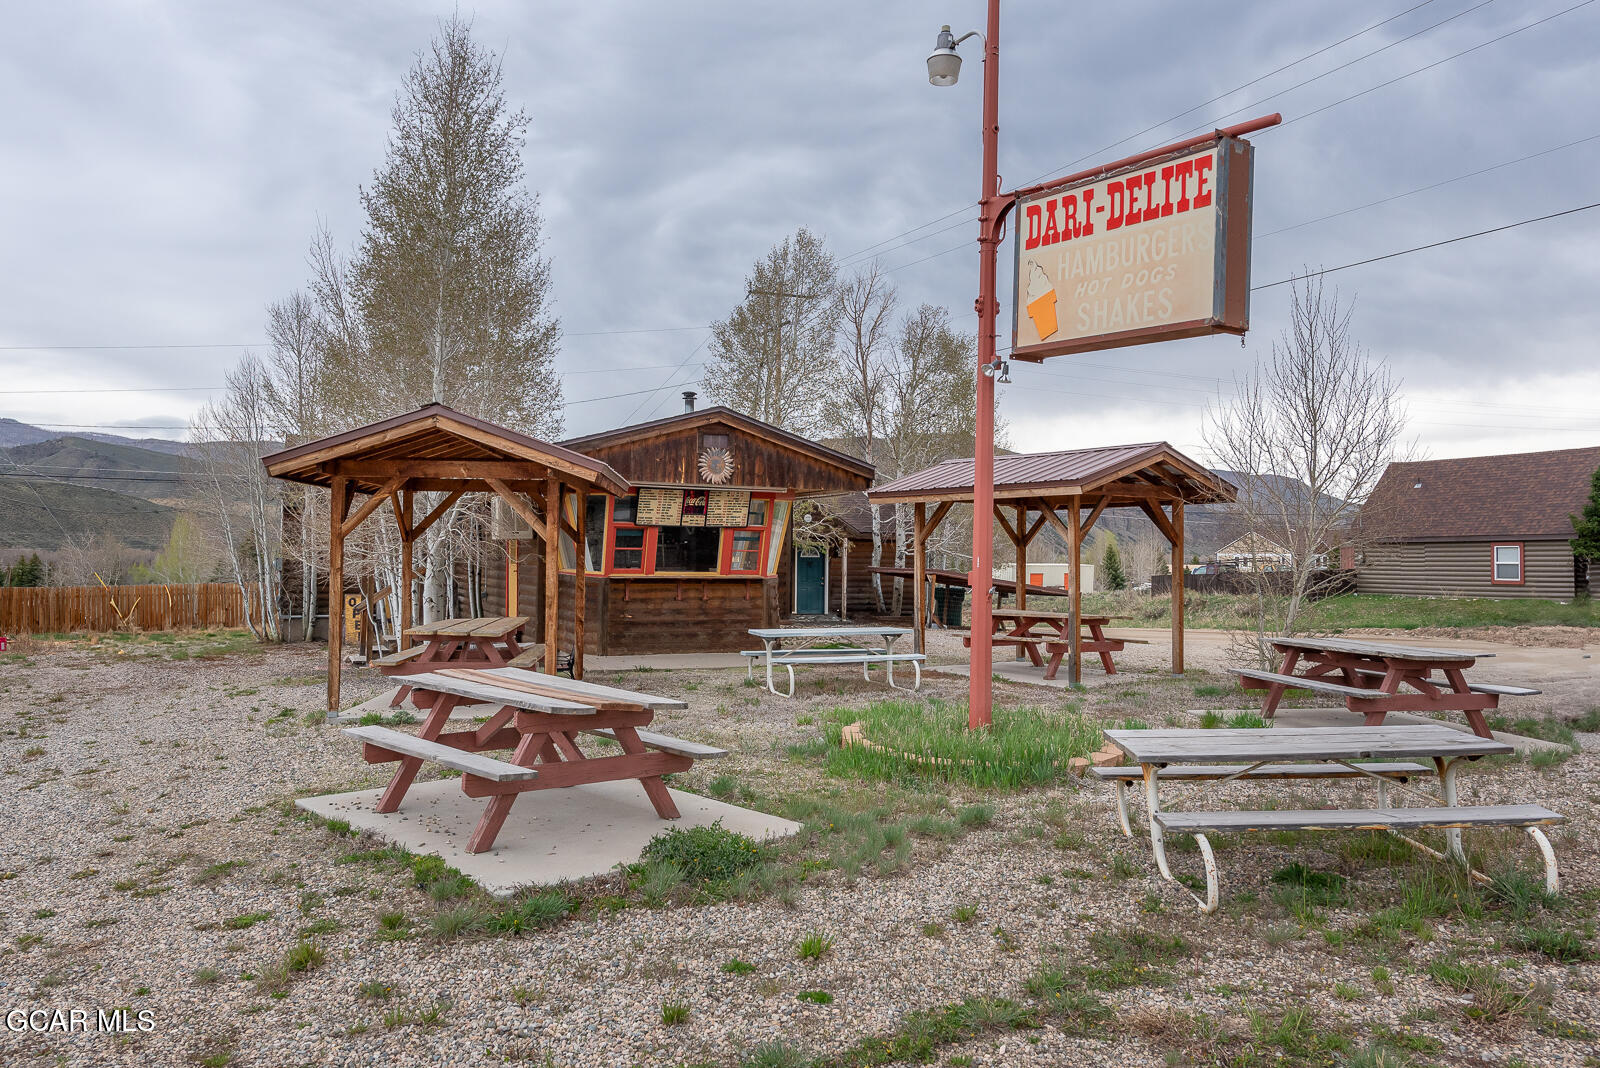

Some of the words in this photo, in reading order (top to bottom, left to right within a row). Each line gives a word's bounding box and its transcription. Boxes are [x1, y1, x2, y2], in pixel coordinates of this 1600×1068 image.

[1025, 154, 1213, 250] DARI-DELITE
[1058, 222, 1213, 281] HAMBURGERS
[1074, 277, 1113, 298] HOT
[1121, 264, 1177, 289] DOGS
[1077, 287, 1173, 332] SHAKES
